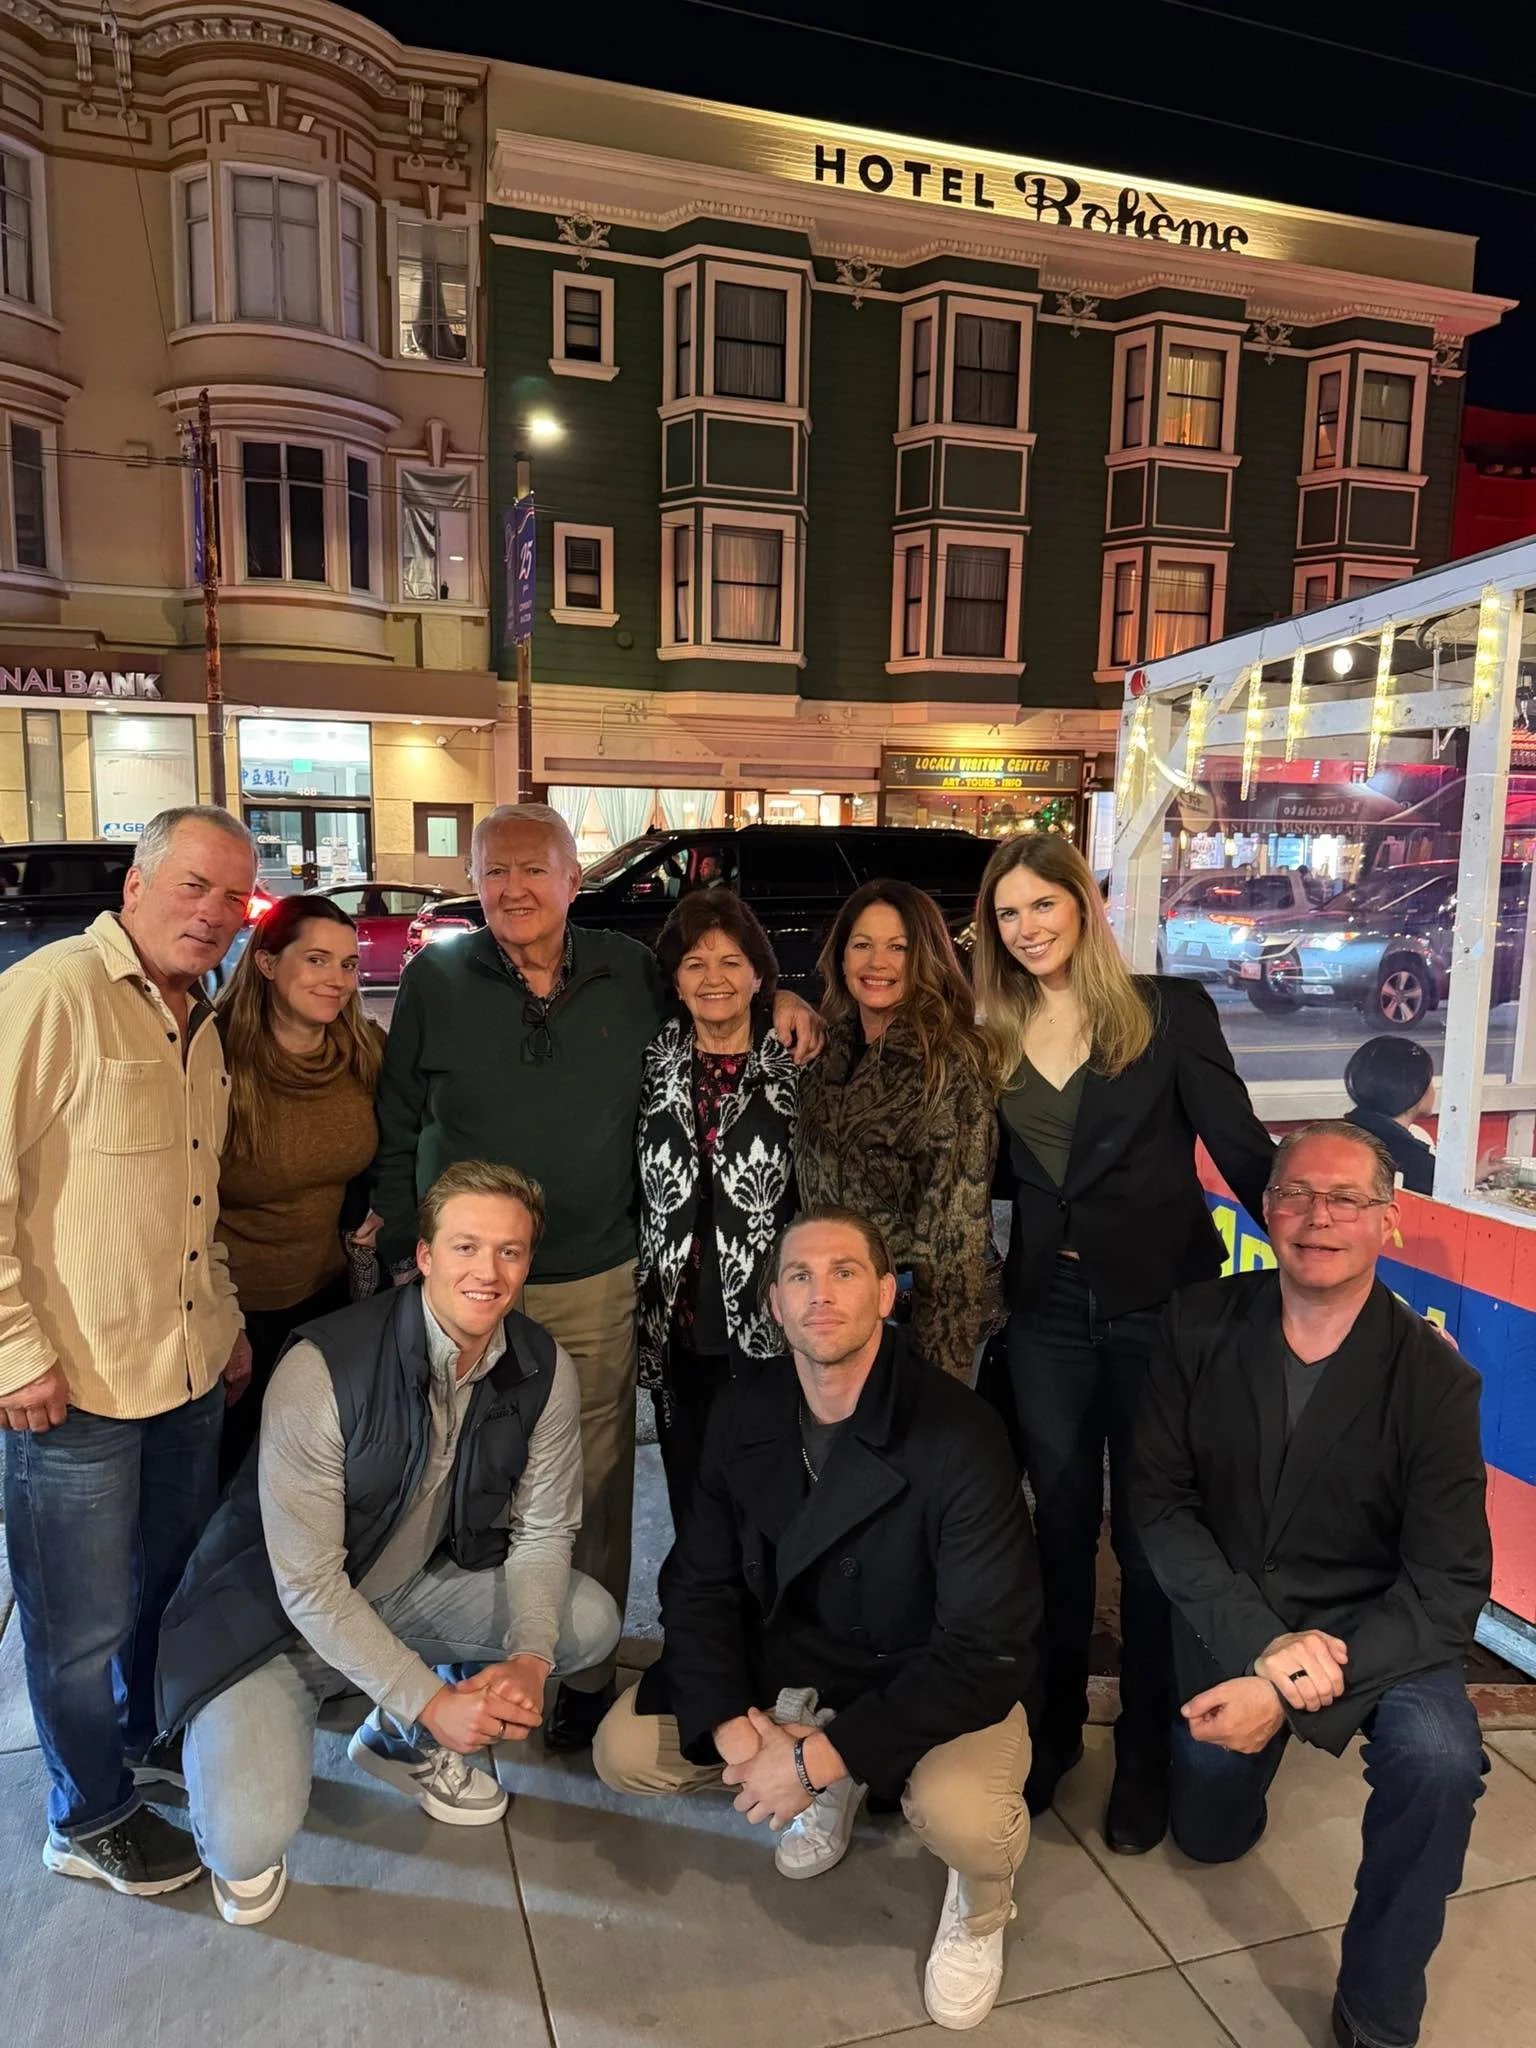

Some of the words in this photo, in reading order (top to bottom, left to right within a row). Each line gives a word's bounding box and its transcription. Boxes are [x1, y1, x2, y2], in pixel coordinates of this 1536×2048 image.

[815, 144, 995, 210] HOTEL
[1014, 170, 1249, 254] Bohème
[518, 540, 534, 580] 25
[0, 666, 62, 693] NAL
[63, 669, 162, 699] BANK
[959, 758, 1004, 772] VISITOR
[1007, 759, 1050, 772] CENTER
[942, 777, 961, 787] ART
[966, 777, 996, 787] TOURS
[1001, 778, 1022, 788] INFO
[1281, 823, 1324, 835] PASTRY
